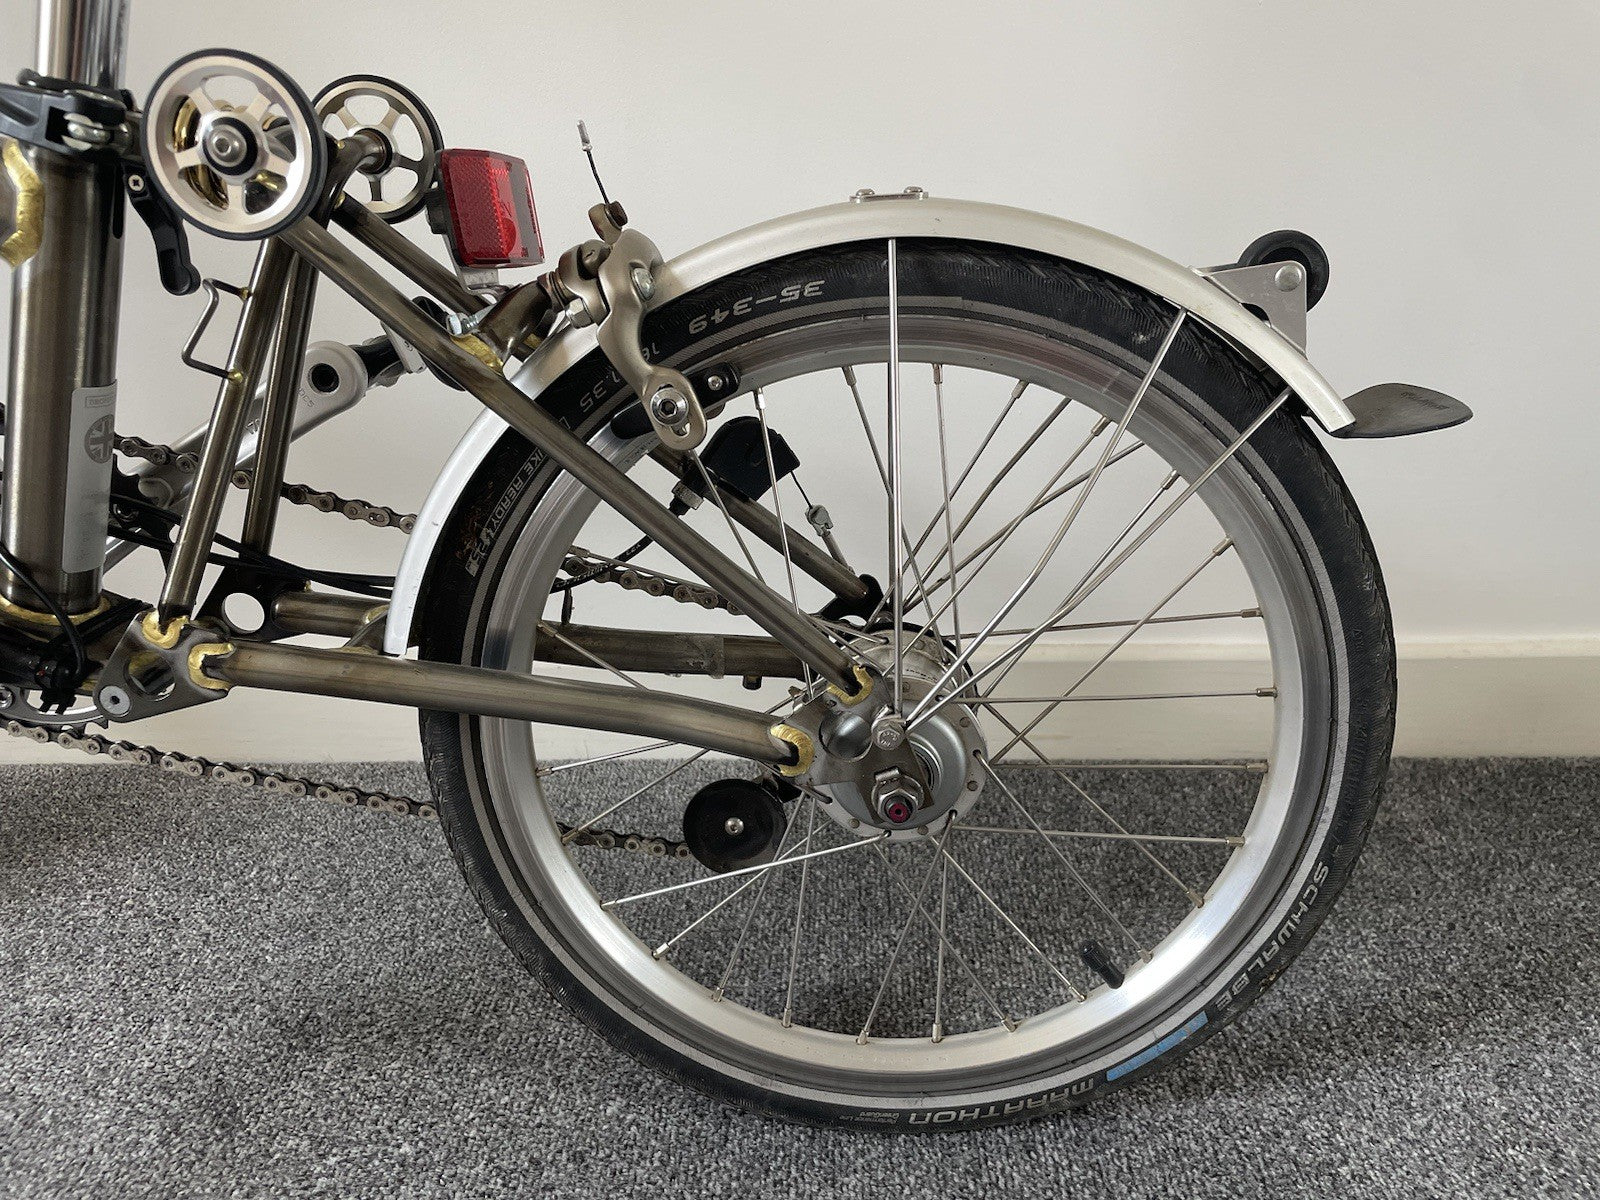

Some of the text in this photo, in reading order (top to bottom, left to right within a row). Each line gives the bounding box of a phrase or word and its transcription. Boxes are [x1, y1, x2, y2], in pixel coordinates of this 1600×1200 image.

[689, 280, 825, 334] 35-349
[492, 477, 525, 530] READY
[1216, 861, 1329, 1008] SCHWALBE
[908, 1077, 1094, 1125] MARATHON
